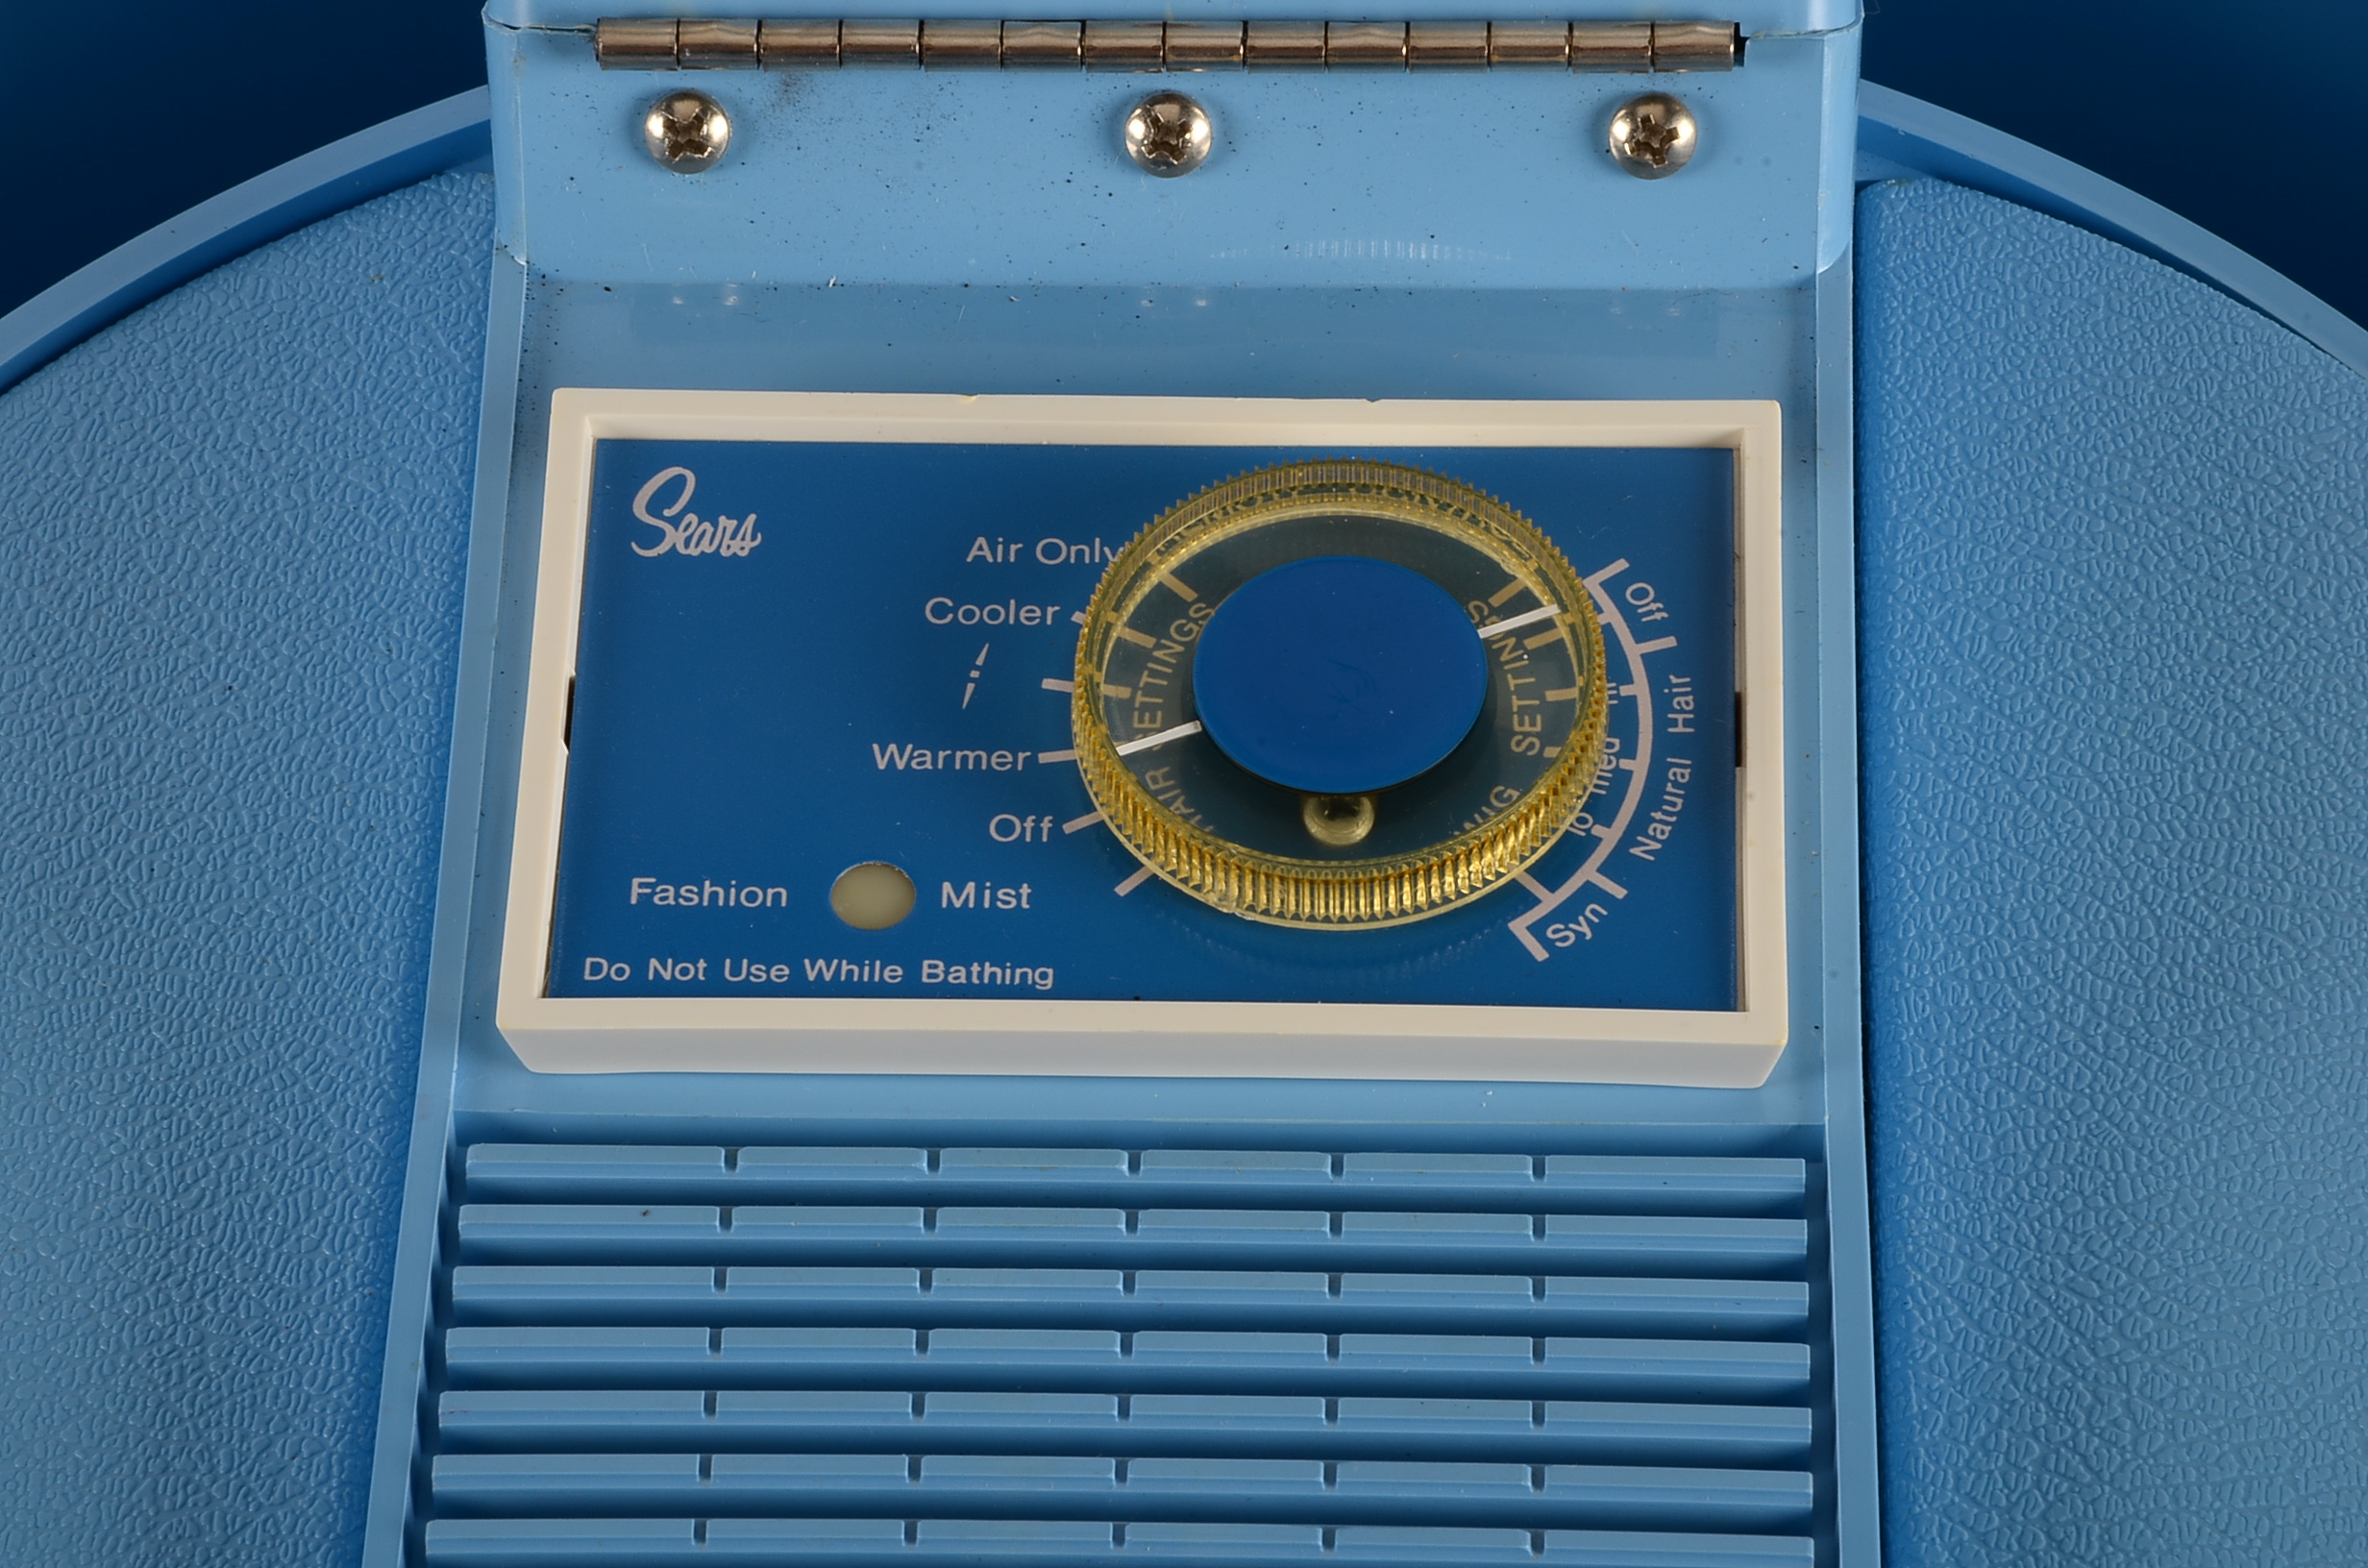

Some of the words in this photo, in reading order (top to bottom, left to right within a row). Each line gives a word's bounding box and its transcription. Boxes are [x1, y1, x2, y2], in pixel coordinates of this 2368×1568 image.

[631, 467, 761, 557] Sears
[966, 537, 1024, 563] Air
[925, 597, 1061, 625] Cooler
[1625, 581, 1669, 622] Off
[872, 743, 1031, 771] Warmer
[1628, 756, 1692, 861] Natural
[1663, 674, 1695, 733] Hair
[989, 814, 1053, 843] Off
[629, 877, 788, 908] Fashion
[941, 881, 1032, 909] Mist
[1545, 902, 1609, 948] Syn
[583, 957, 630, 981] Do
[648, 958, 707, 981] Not
[724, 958, 790, 982] Use
[803, 958, 903, 983] While
[922, 959, 1054, 990] Bathing
